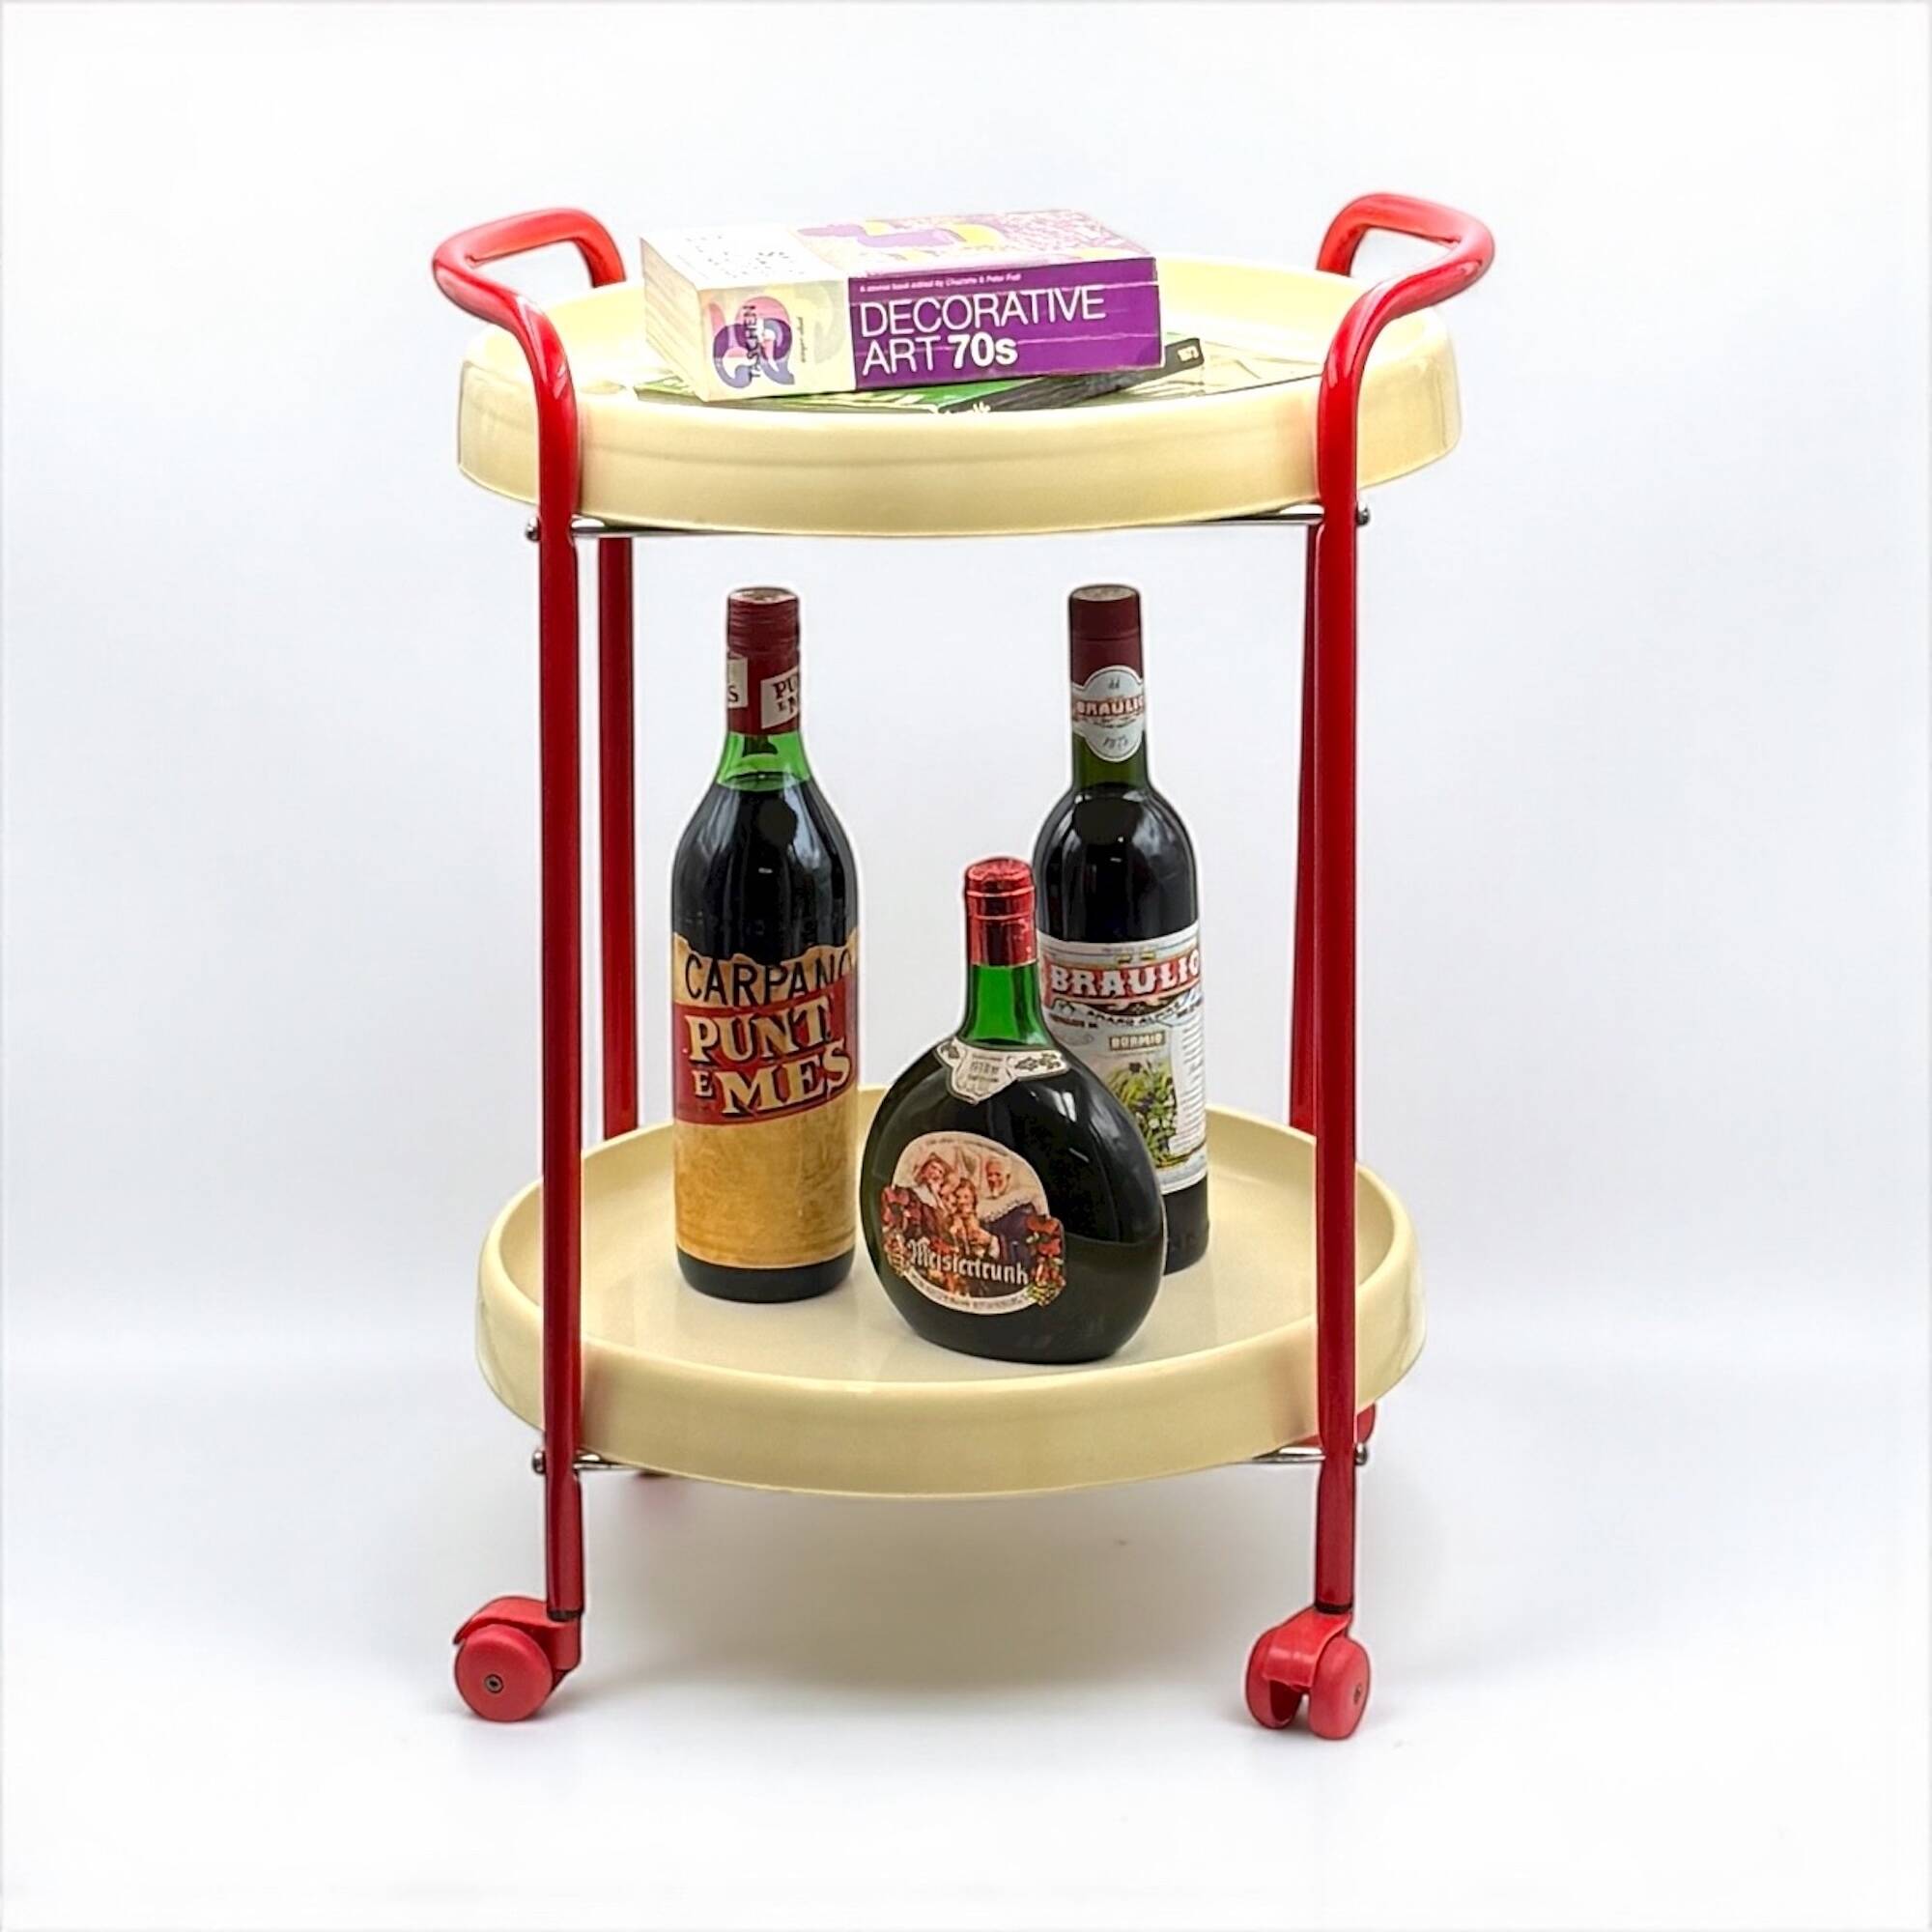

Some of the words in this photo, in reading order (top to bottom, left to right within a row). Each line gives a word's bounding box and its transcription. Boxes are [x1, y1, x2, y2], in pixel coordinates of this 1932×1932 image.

[743, 304, 761, 379] TASCHEN
[860, 284, 1107, 337] DECORATIVE
[862, 334, 942, 377] ART
[947, 331, 1019, 370] 70s
[1051, 948, 1200, 998] BRAULIO
[684, 994, 833, 1065] PUNT
[692, 1067, 714, 1099] E
[714, 1037, 852, 1117] MES
